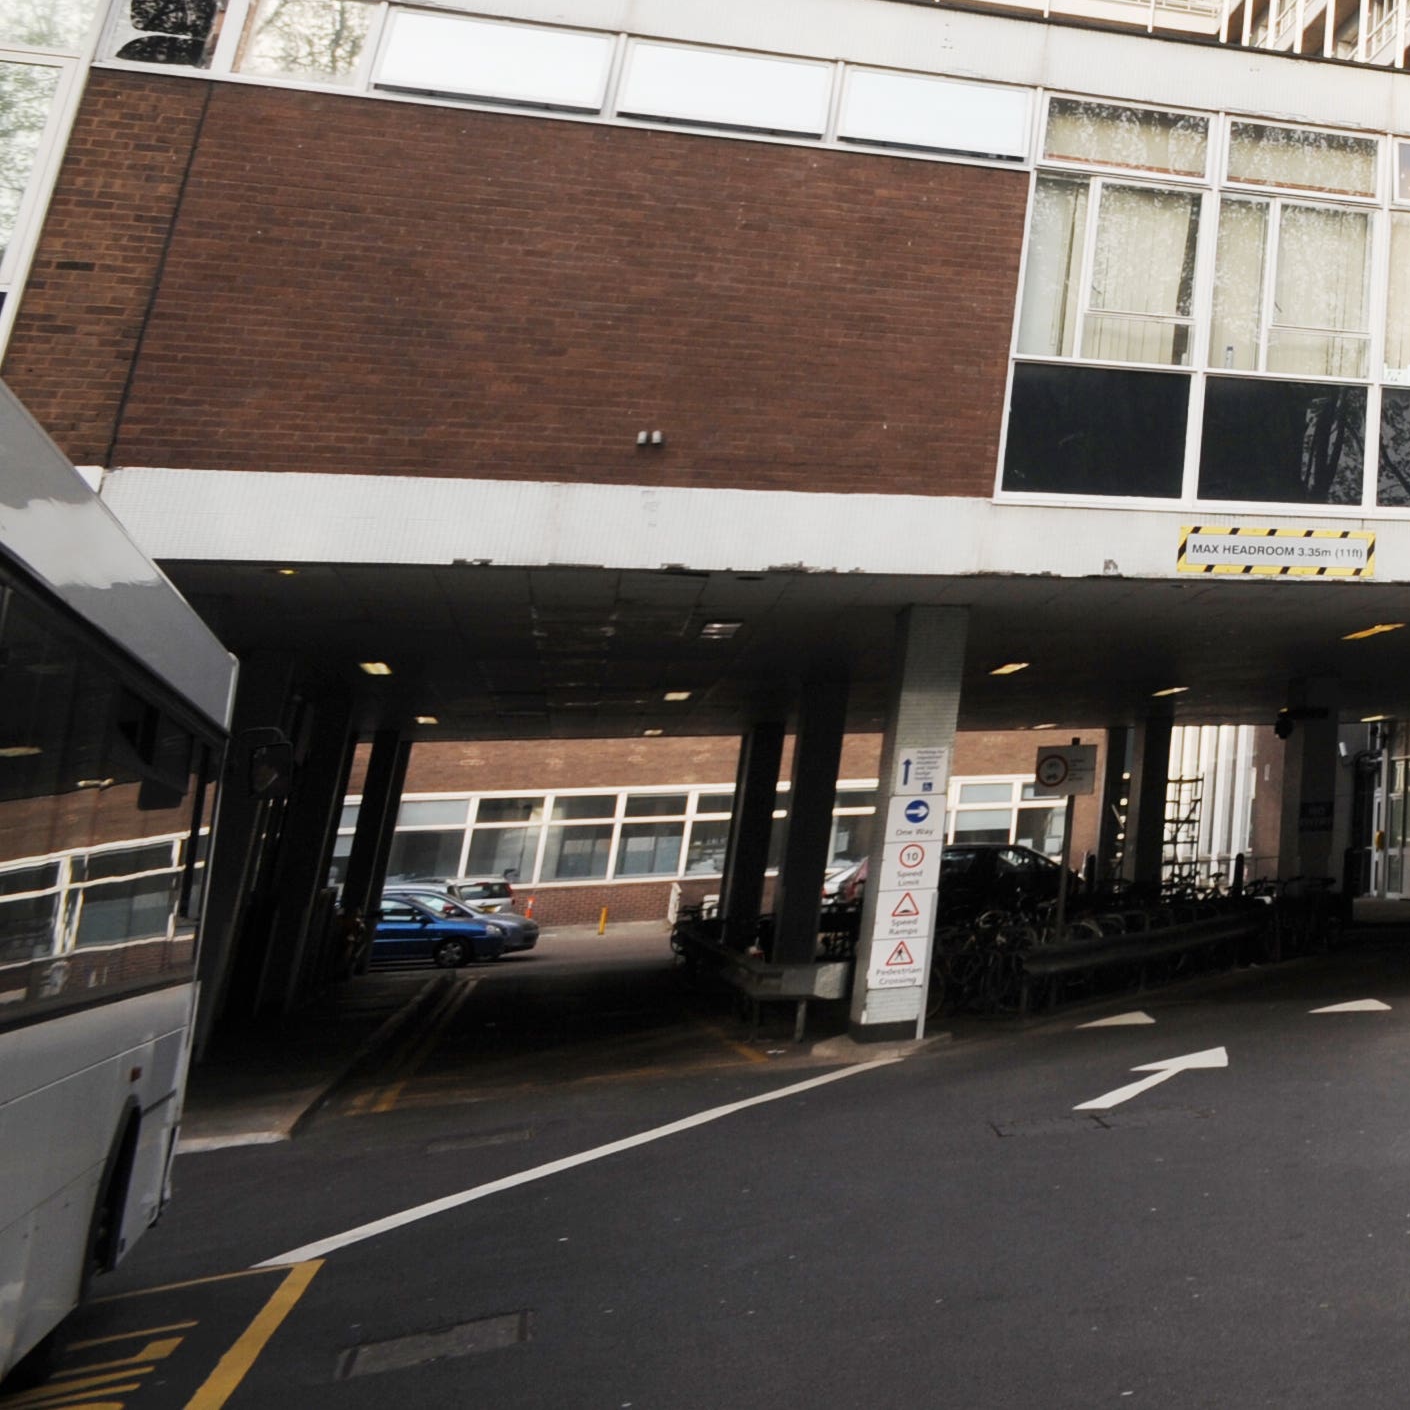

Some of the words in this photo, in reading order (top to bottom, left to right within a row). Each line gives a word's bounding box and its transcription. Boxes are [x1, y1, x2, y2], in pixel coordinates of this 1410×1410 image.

[1192, 543, 1219, 554] MAX
[1222, 544, 1295, 556] HEADROOM
[1297, 547, 1331, 557] 3.35m
[1334, 548, 1363, 559] (11ft)
[915, 828, 934, 836] Way
[906, 852, 919, 861] 10
[897, 870, 923, 878] Speed
[897, 879, 919, 887] Limit
[891, 918, 918, 927] Speed
